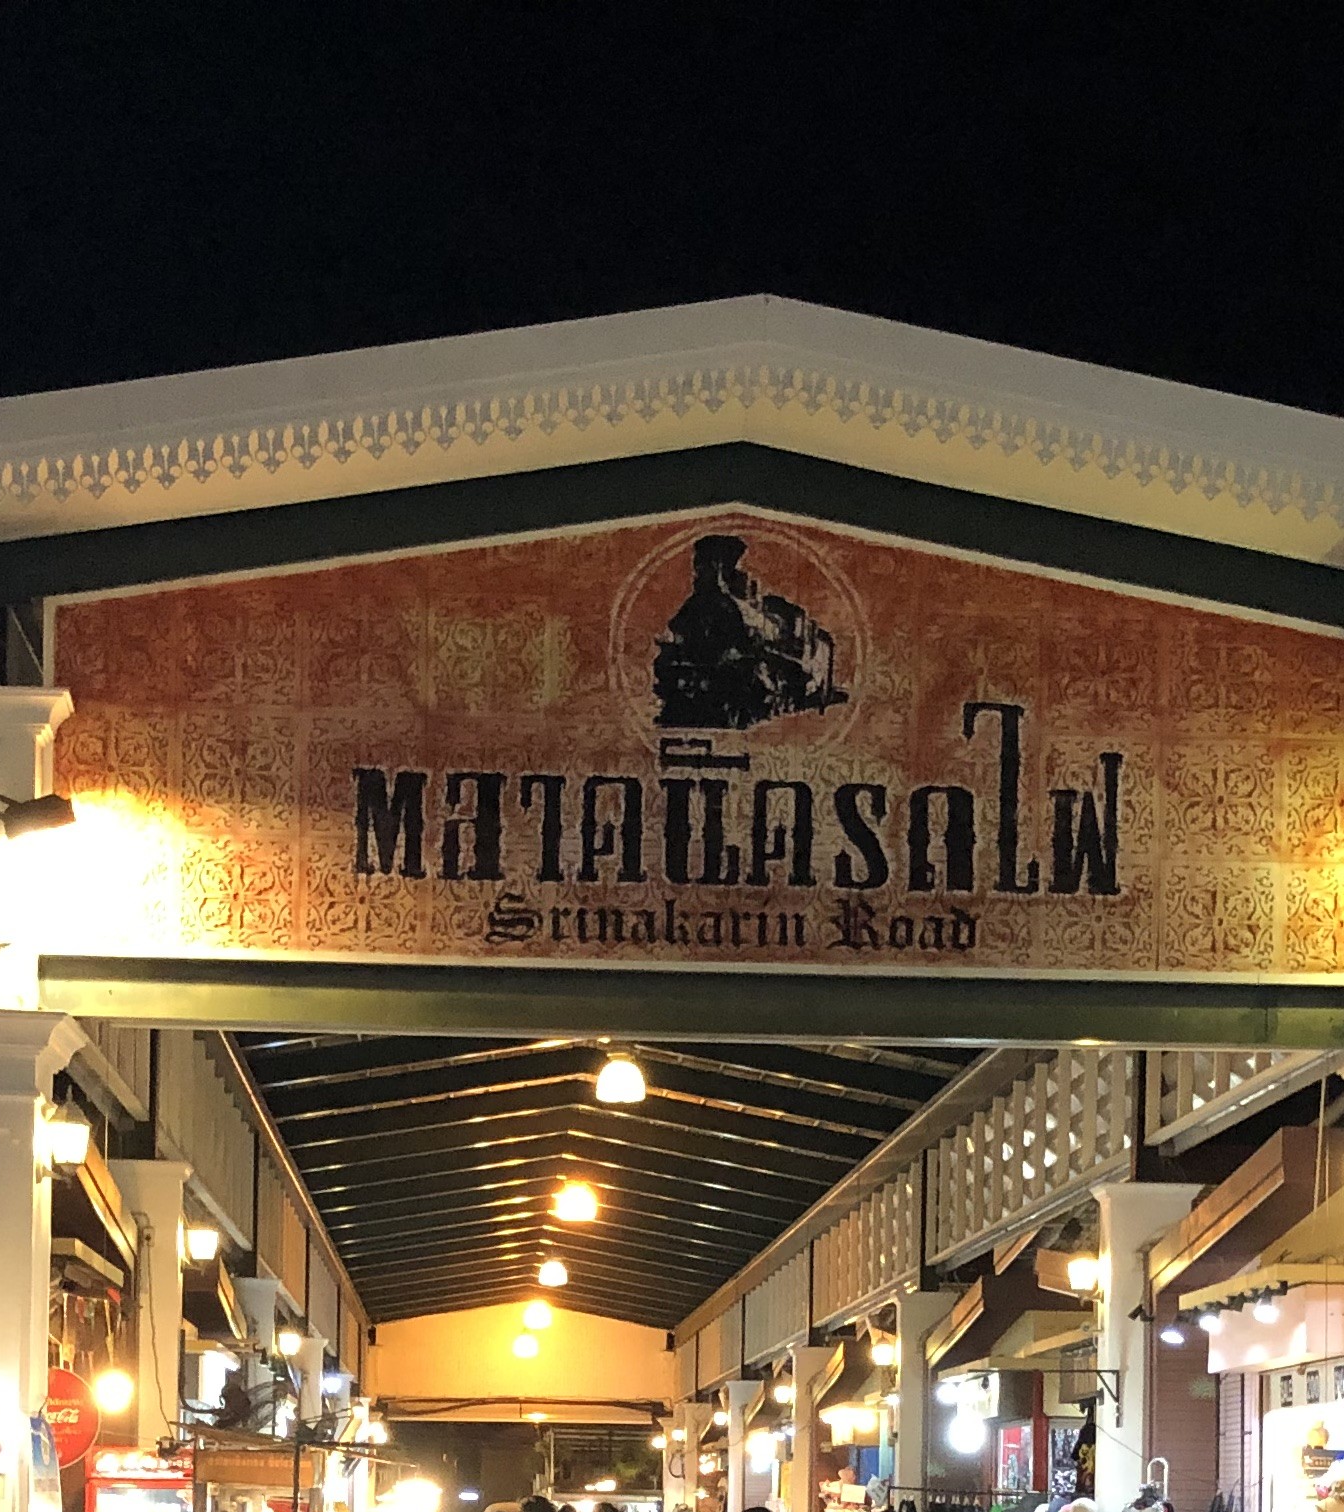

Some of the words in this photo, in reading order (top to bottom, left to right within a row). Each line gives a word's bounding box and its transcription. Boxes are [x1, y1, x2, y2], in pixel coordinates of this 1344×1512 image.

[353, 702, 1123, 896] ตลาดนัดรถไฟ
[486, 895, 809, 947] Srinakarin
[826, 898, 978, 952] Road
